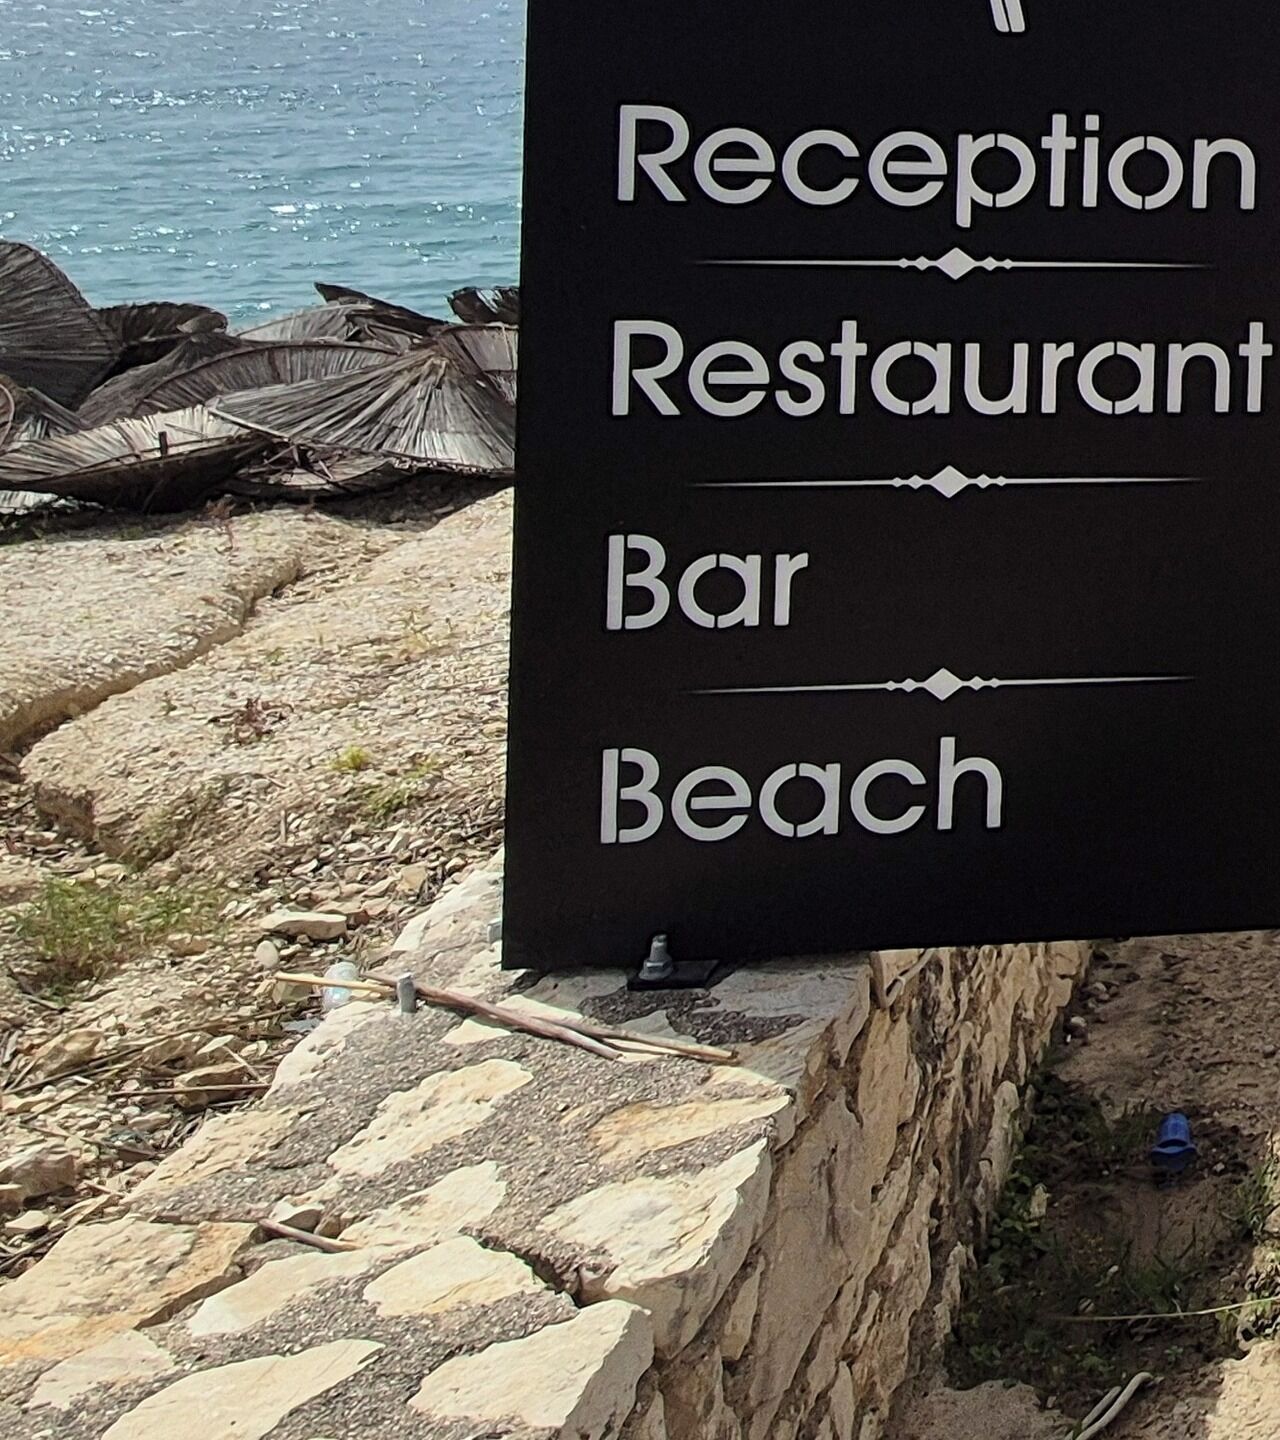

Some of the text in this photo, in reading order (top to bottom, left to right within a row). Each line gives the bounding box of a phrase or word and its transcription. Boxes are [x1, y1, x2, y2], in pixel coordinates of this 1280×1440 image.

[616, 104, 1257, 228] Reception
[611, 319, 1275, 418] Restaurant
[605, 533, 810, 631] Bar
[600, 736, 1004, 844] Beach
